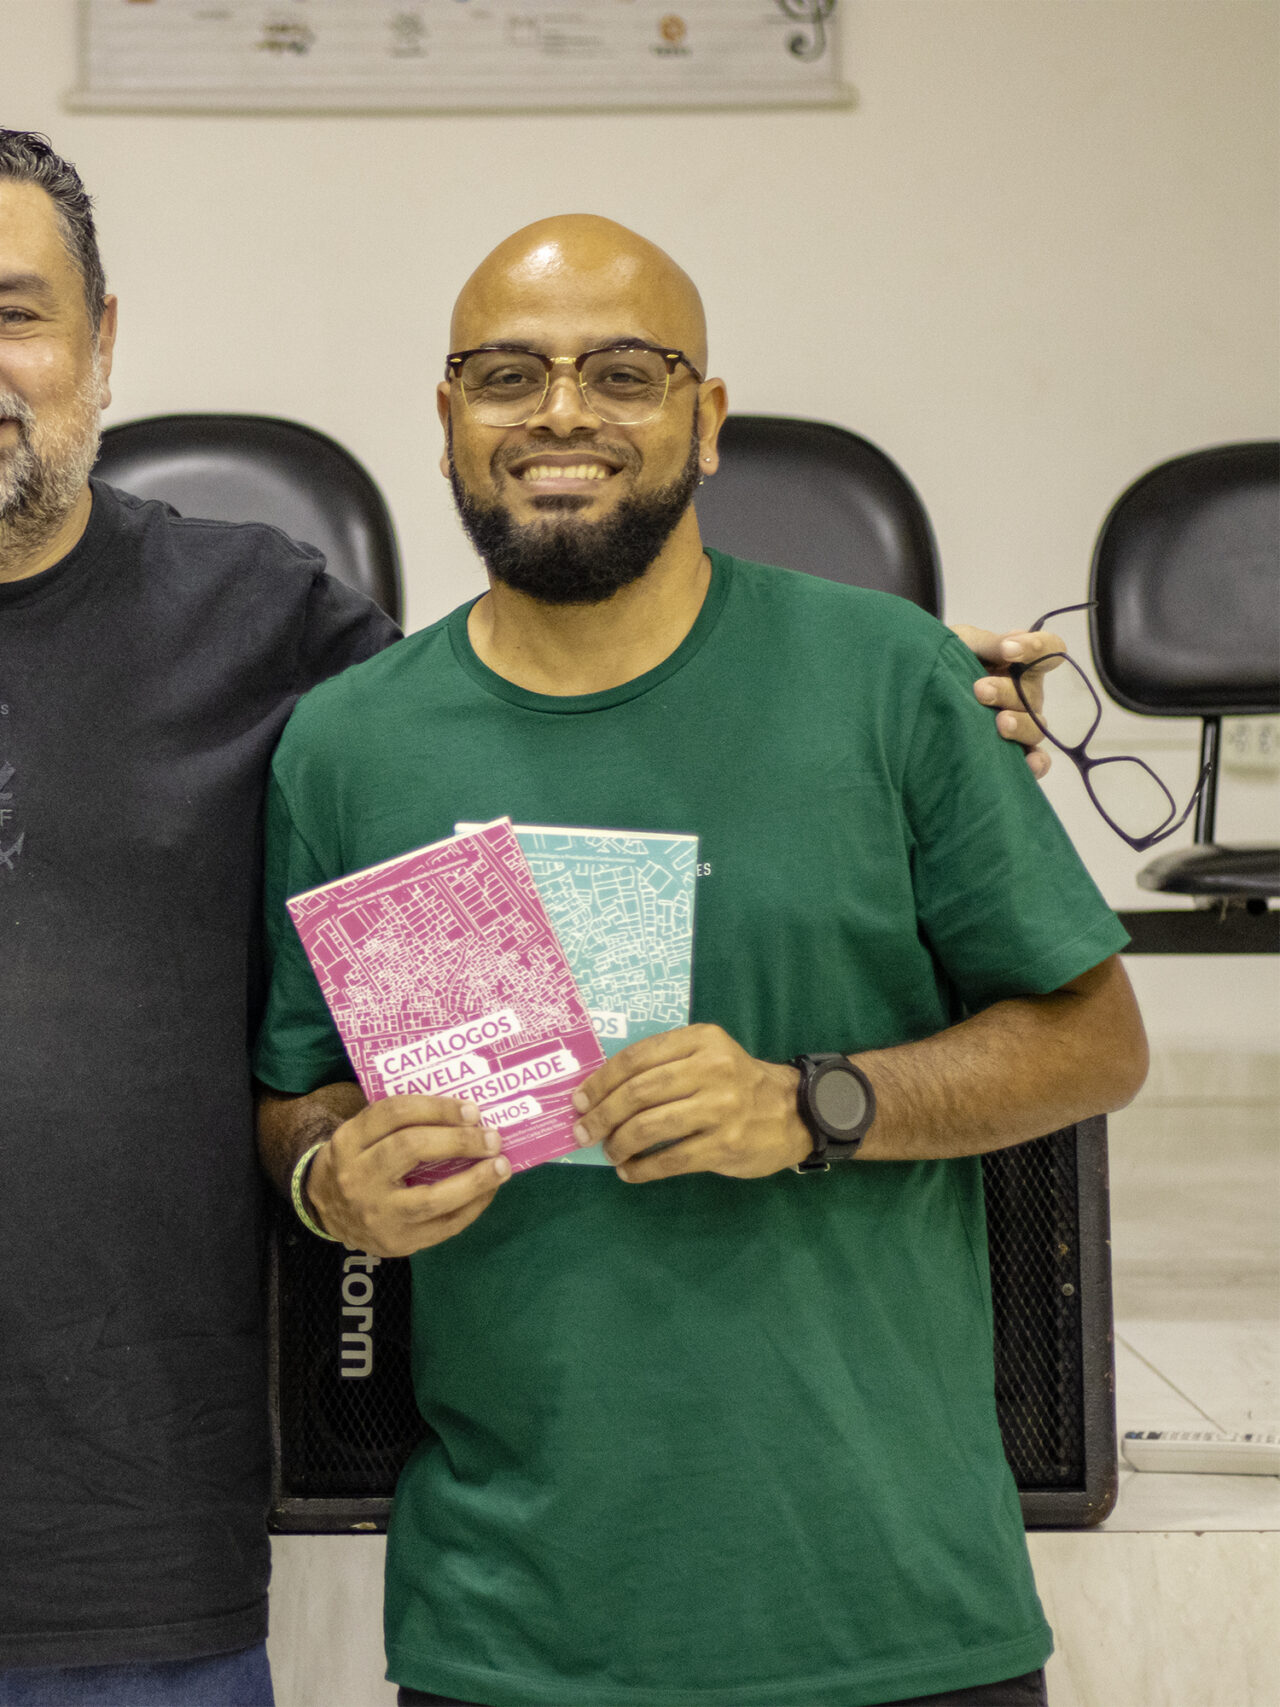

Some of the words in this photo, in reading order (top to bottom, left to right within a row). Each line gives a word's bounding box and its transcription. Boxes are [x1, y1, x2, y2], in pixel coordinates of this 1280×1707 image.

[0, 809, 13, 827] F
[383, 1016, 512, 1076] CATÁLOGOS
[452, 1055, 566, 1105] ERSIDADE
